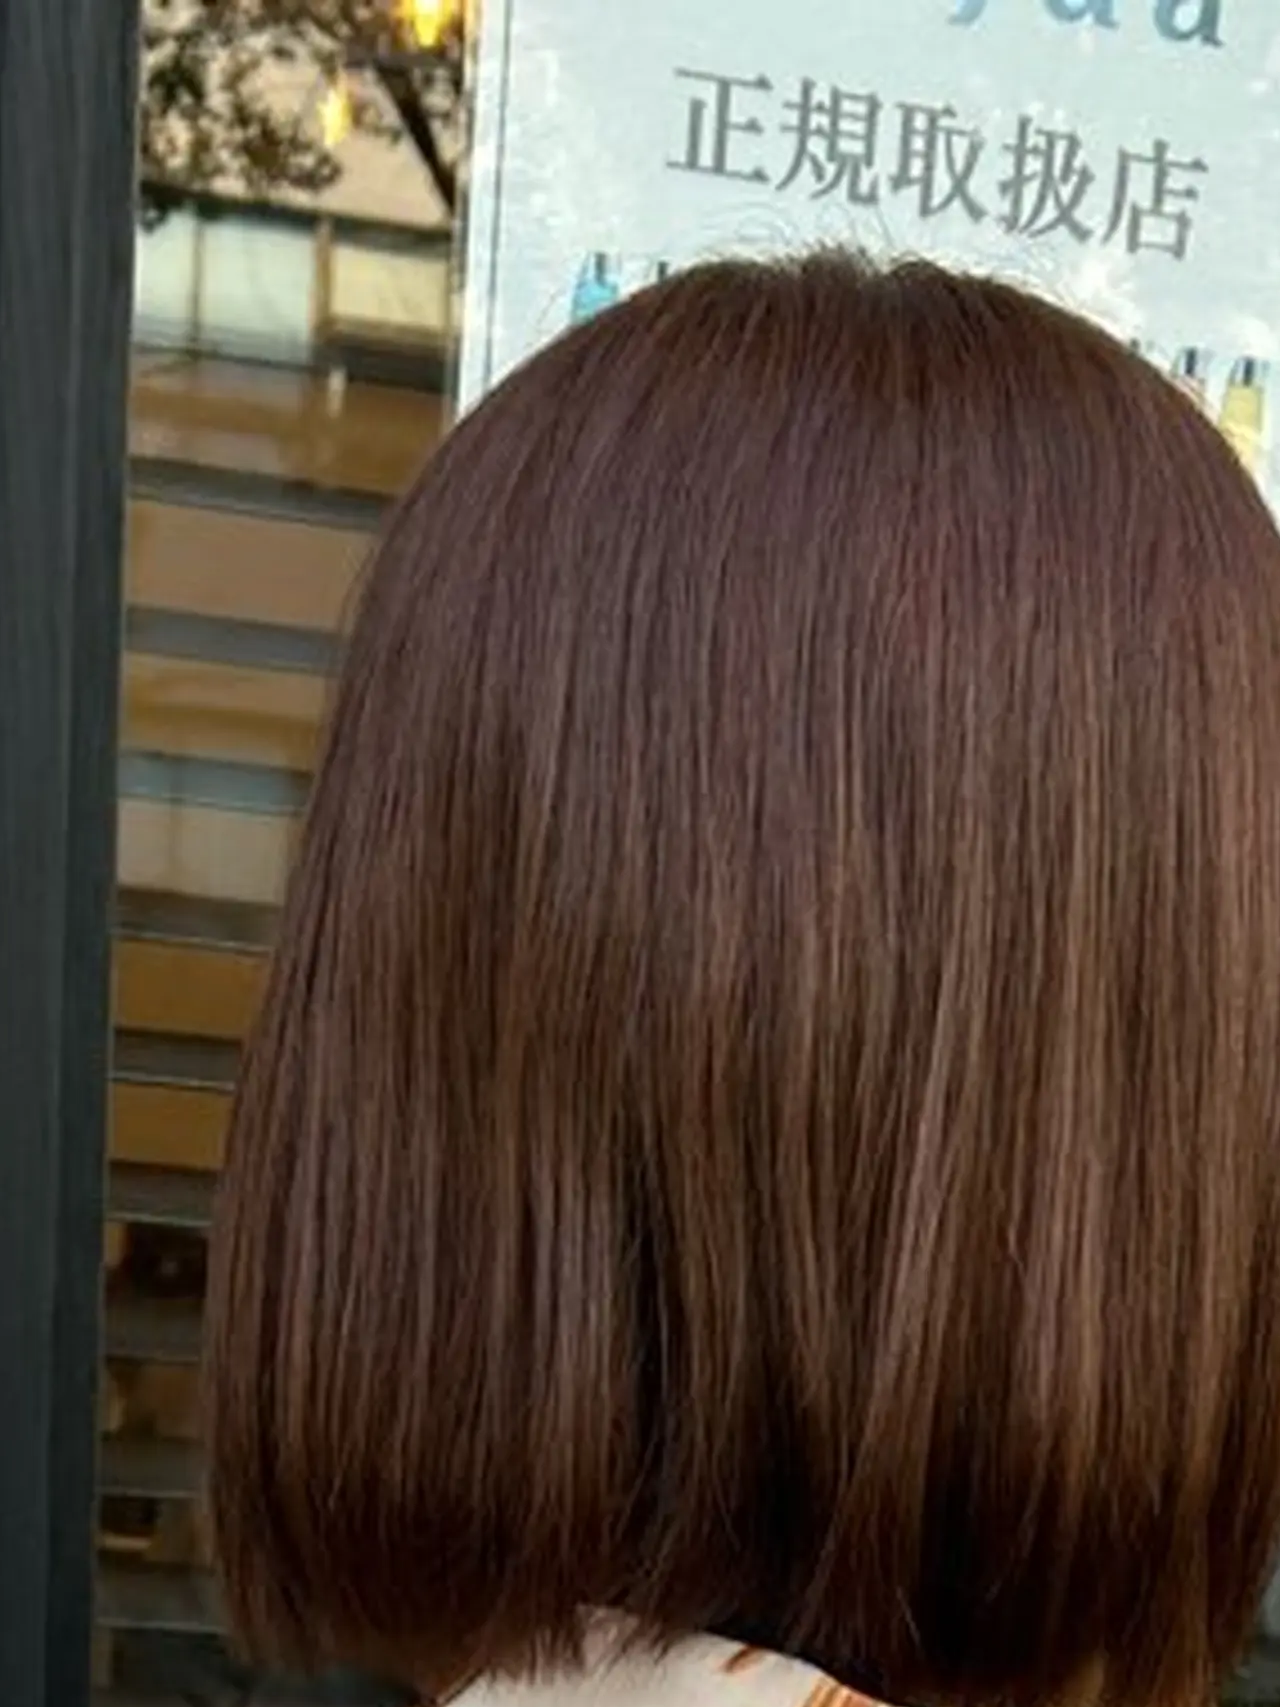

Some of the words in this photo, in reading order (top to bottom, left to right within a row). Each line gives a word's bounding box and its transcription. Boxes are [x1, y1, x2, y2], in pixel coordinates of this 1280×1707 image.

[665, 68, 1208, 260] 正規取扱店
